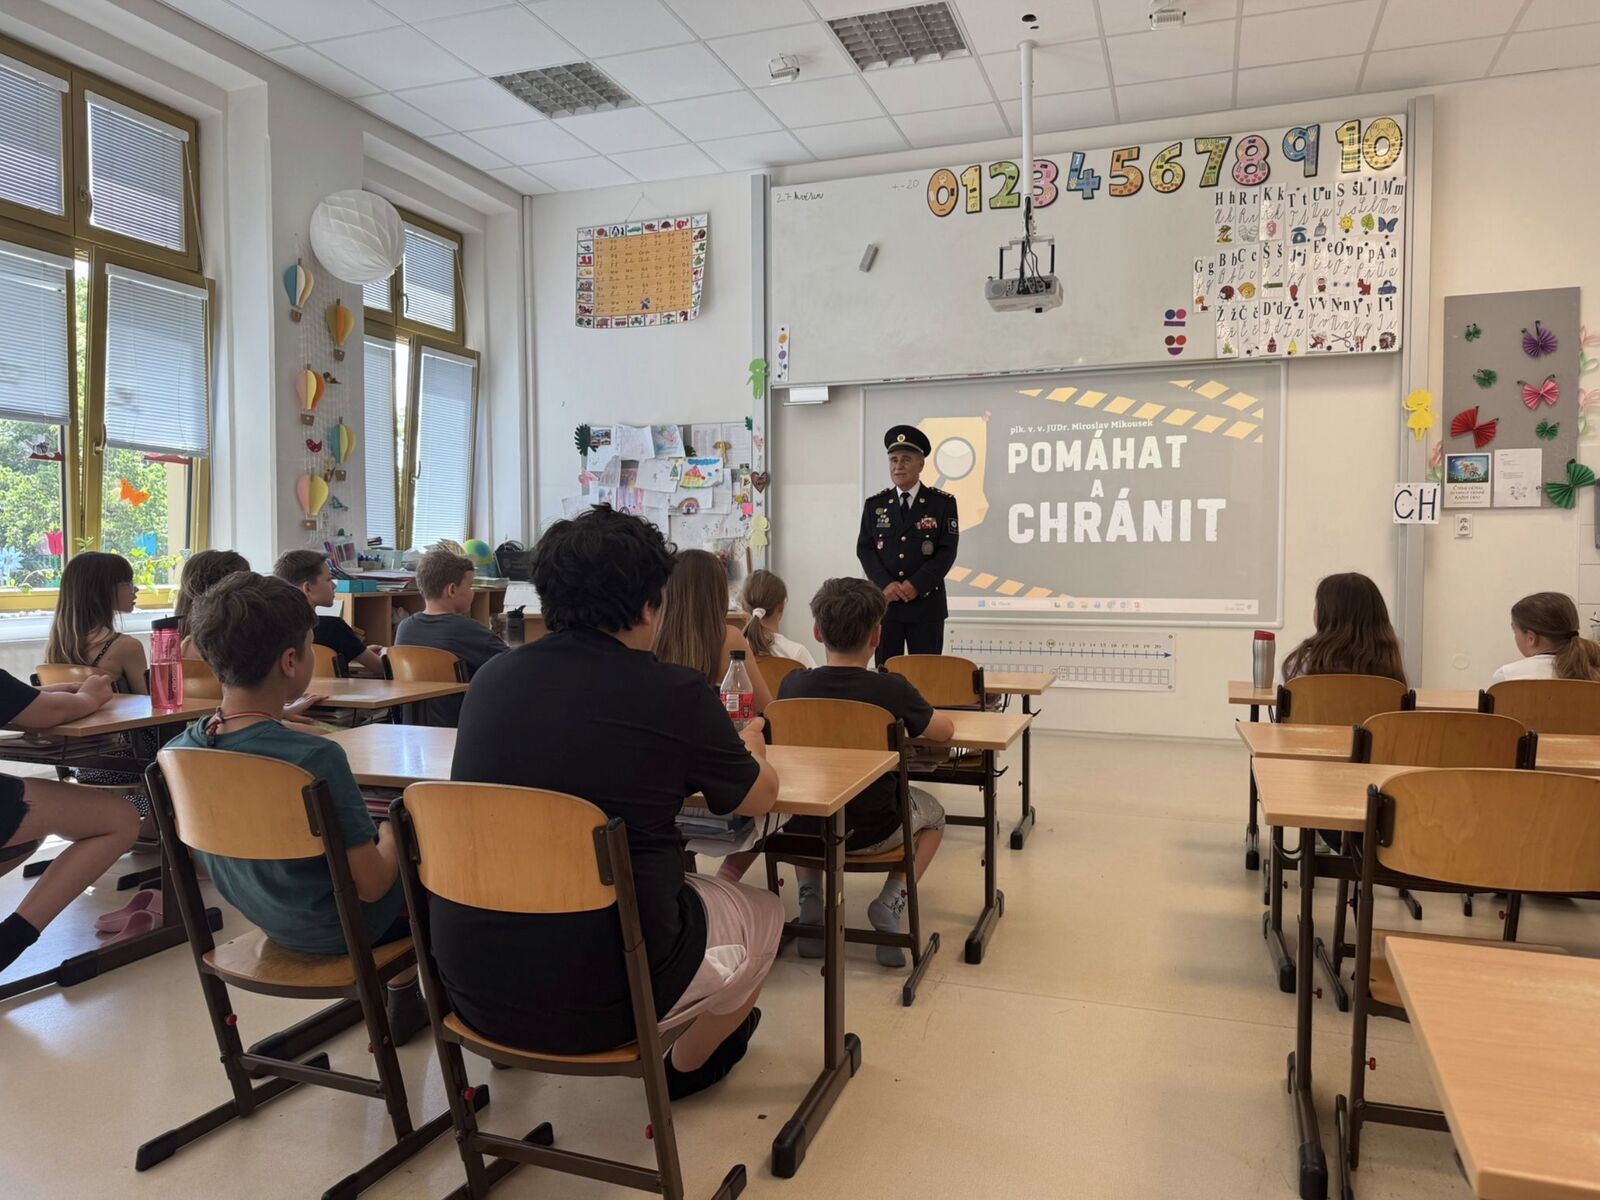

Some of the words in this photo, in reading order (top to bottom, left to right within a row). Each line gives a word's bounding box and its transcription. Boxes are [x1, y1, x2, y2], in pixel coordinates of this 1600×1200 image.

[926, 168, 959, 217] 0
[960, 164, 982, 214] 1
[988, 160, 1021, 210] 2
[1032, 158, 1059, 208] 3
[1066, 152, 1100, 200] 4
[1109, 146, 1144, 197] 5
[1150, 142, 1185, 194] 6
[1194, 136, 1232, 188] 7
[1232, 134, 1271, 186] 8
[1282, 124, 1320, 178] 9
[1335, 117, 1403, 174] 10
[1010, 425, 1026, 436] plk.
[1046, 424, 1070, 432] JUDr.
[1072, 422, 1109, 430] Miroslav
[1008, 430, 1188, 474] POMÁHAT
[1090, 479, 1104, 498] A
[1394, 488, 1437, 520] CH
[1008, 488, 1226, 544] CHRÁNIT
